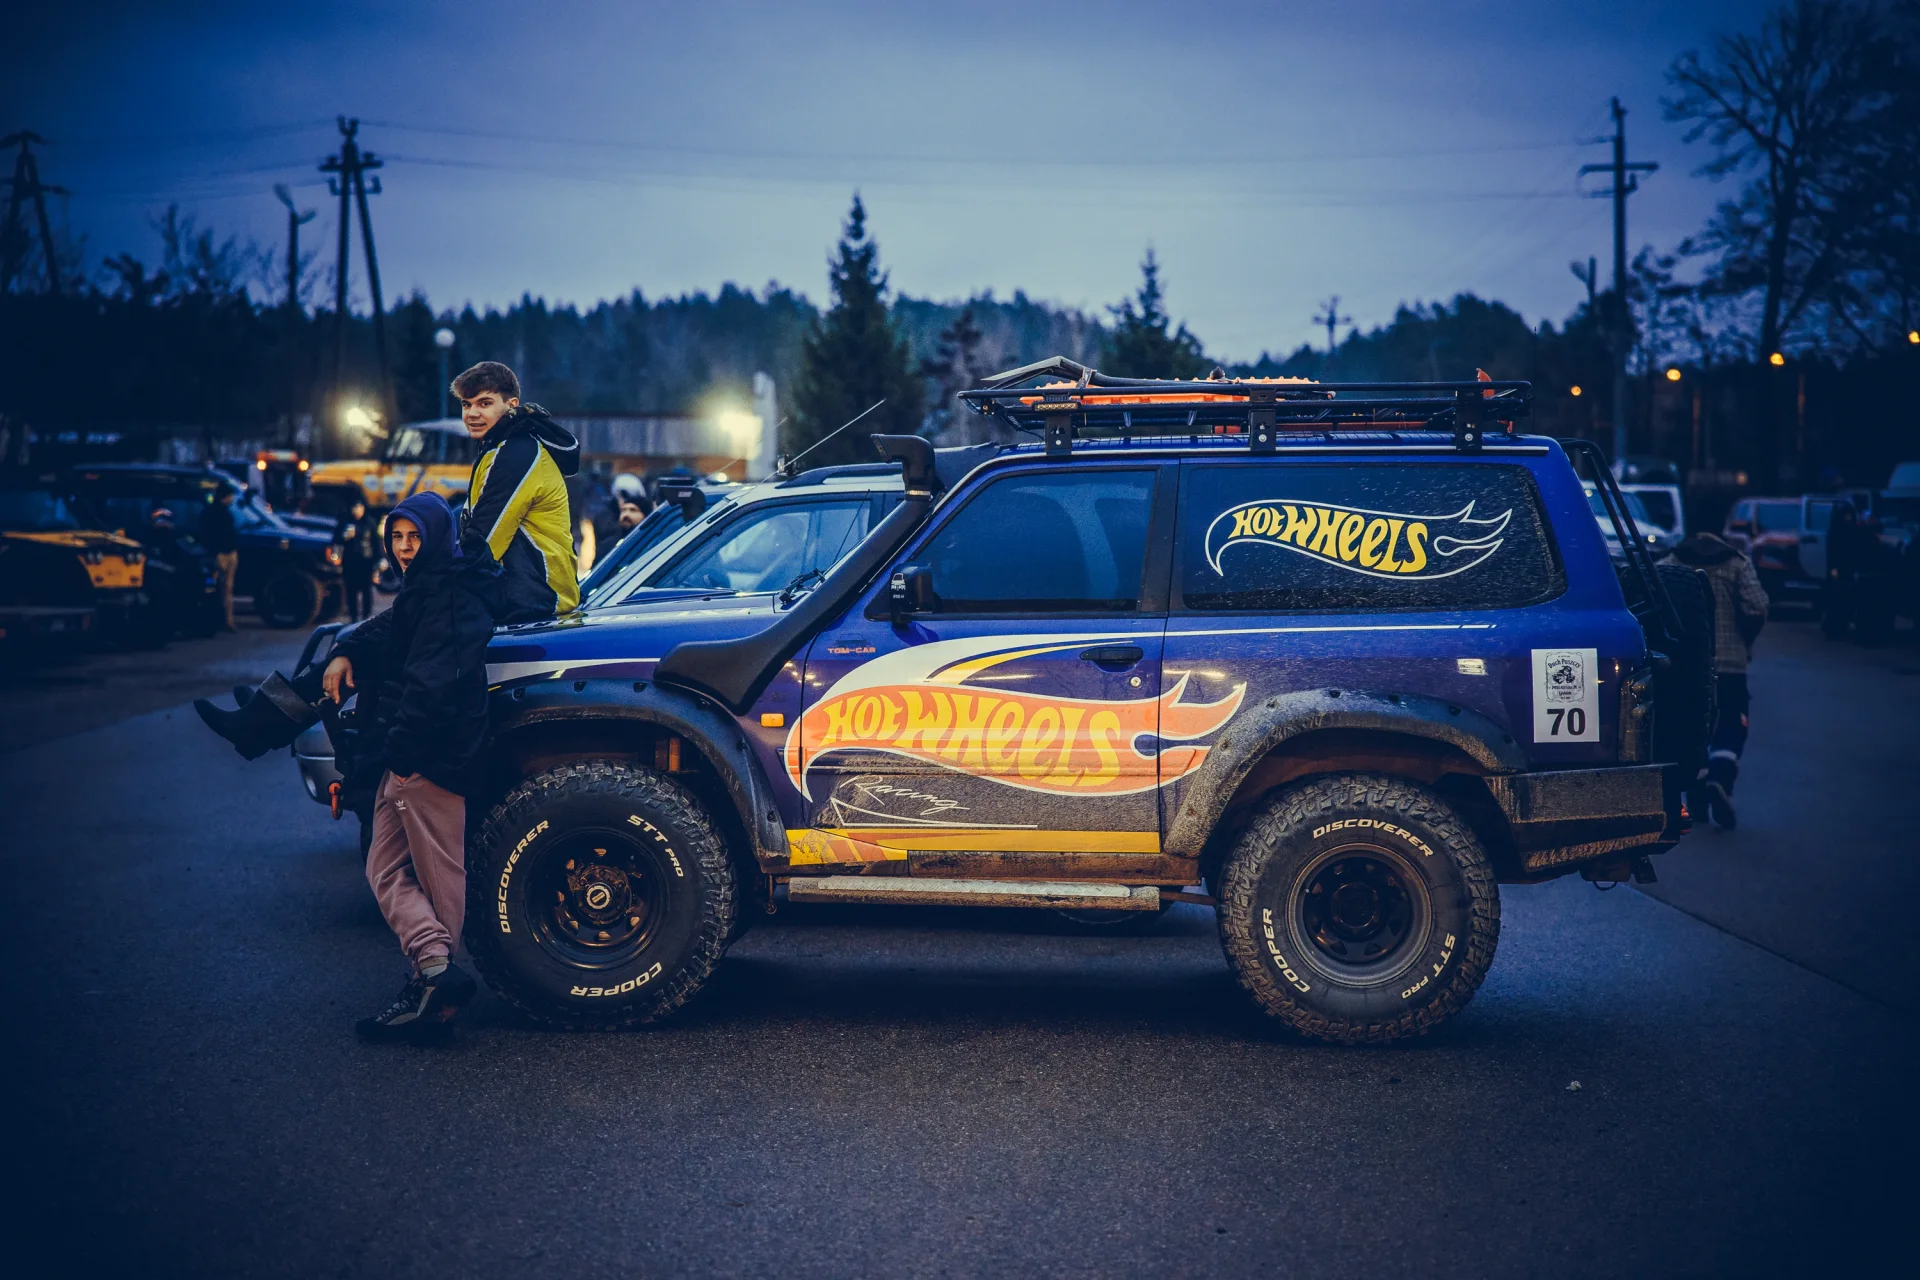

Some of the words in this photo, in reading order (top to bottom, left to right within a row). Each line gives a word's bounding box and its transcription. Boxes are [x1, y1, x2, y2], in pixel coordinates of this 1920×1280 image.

[1547, 708, 1586, 736] 70
[840, 773, 970, 816] Racing
[627, 814, 668, 843] STT
[665, 848, 684, 877] PRO
[1313, 818, 1434, 857] DISCOVERER
[497, 819, 549, 933] DISCOVERER
[1262, 908, 1311, 993] COOPER
[1434, 932, 1457, 978] STT
[570, 961, 663, 997] COOPER
[1401, 976, 1429, 999] PRO
